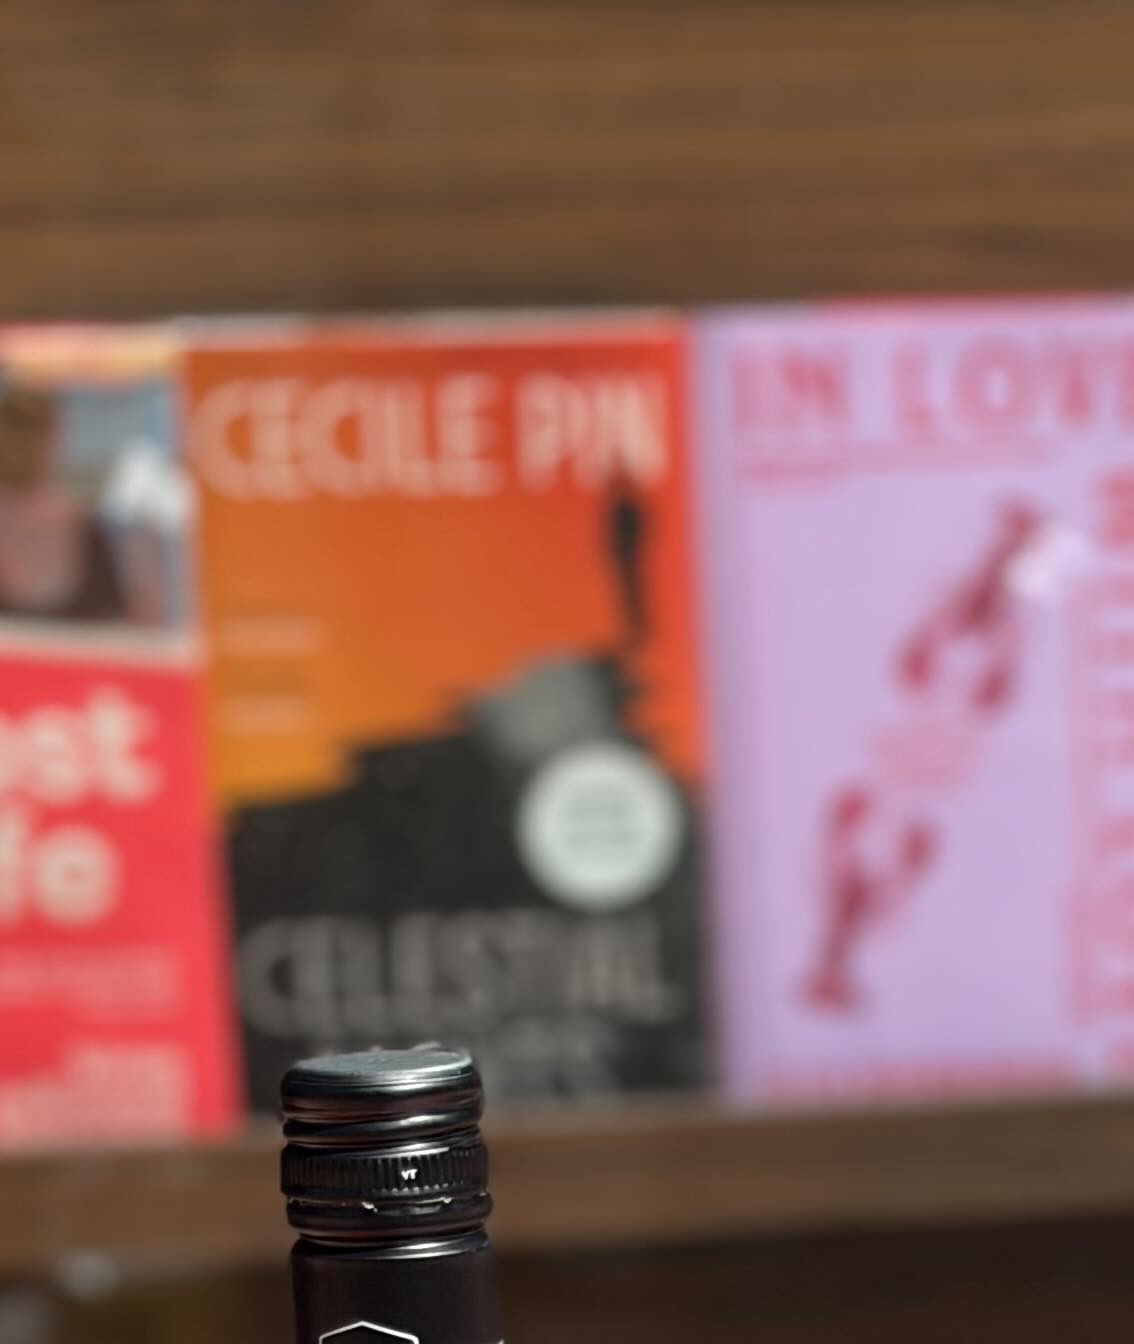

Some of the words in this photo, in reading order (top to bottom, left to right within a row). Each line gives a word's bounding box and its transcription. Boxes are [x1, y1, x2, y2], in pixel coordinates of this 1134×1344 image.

[193, 372, 505, 502] CECILE
[514, 370, 672, 496] PIN
[730, 340, 853, 434] IN
